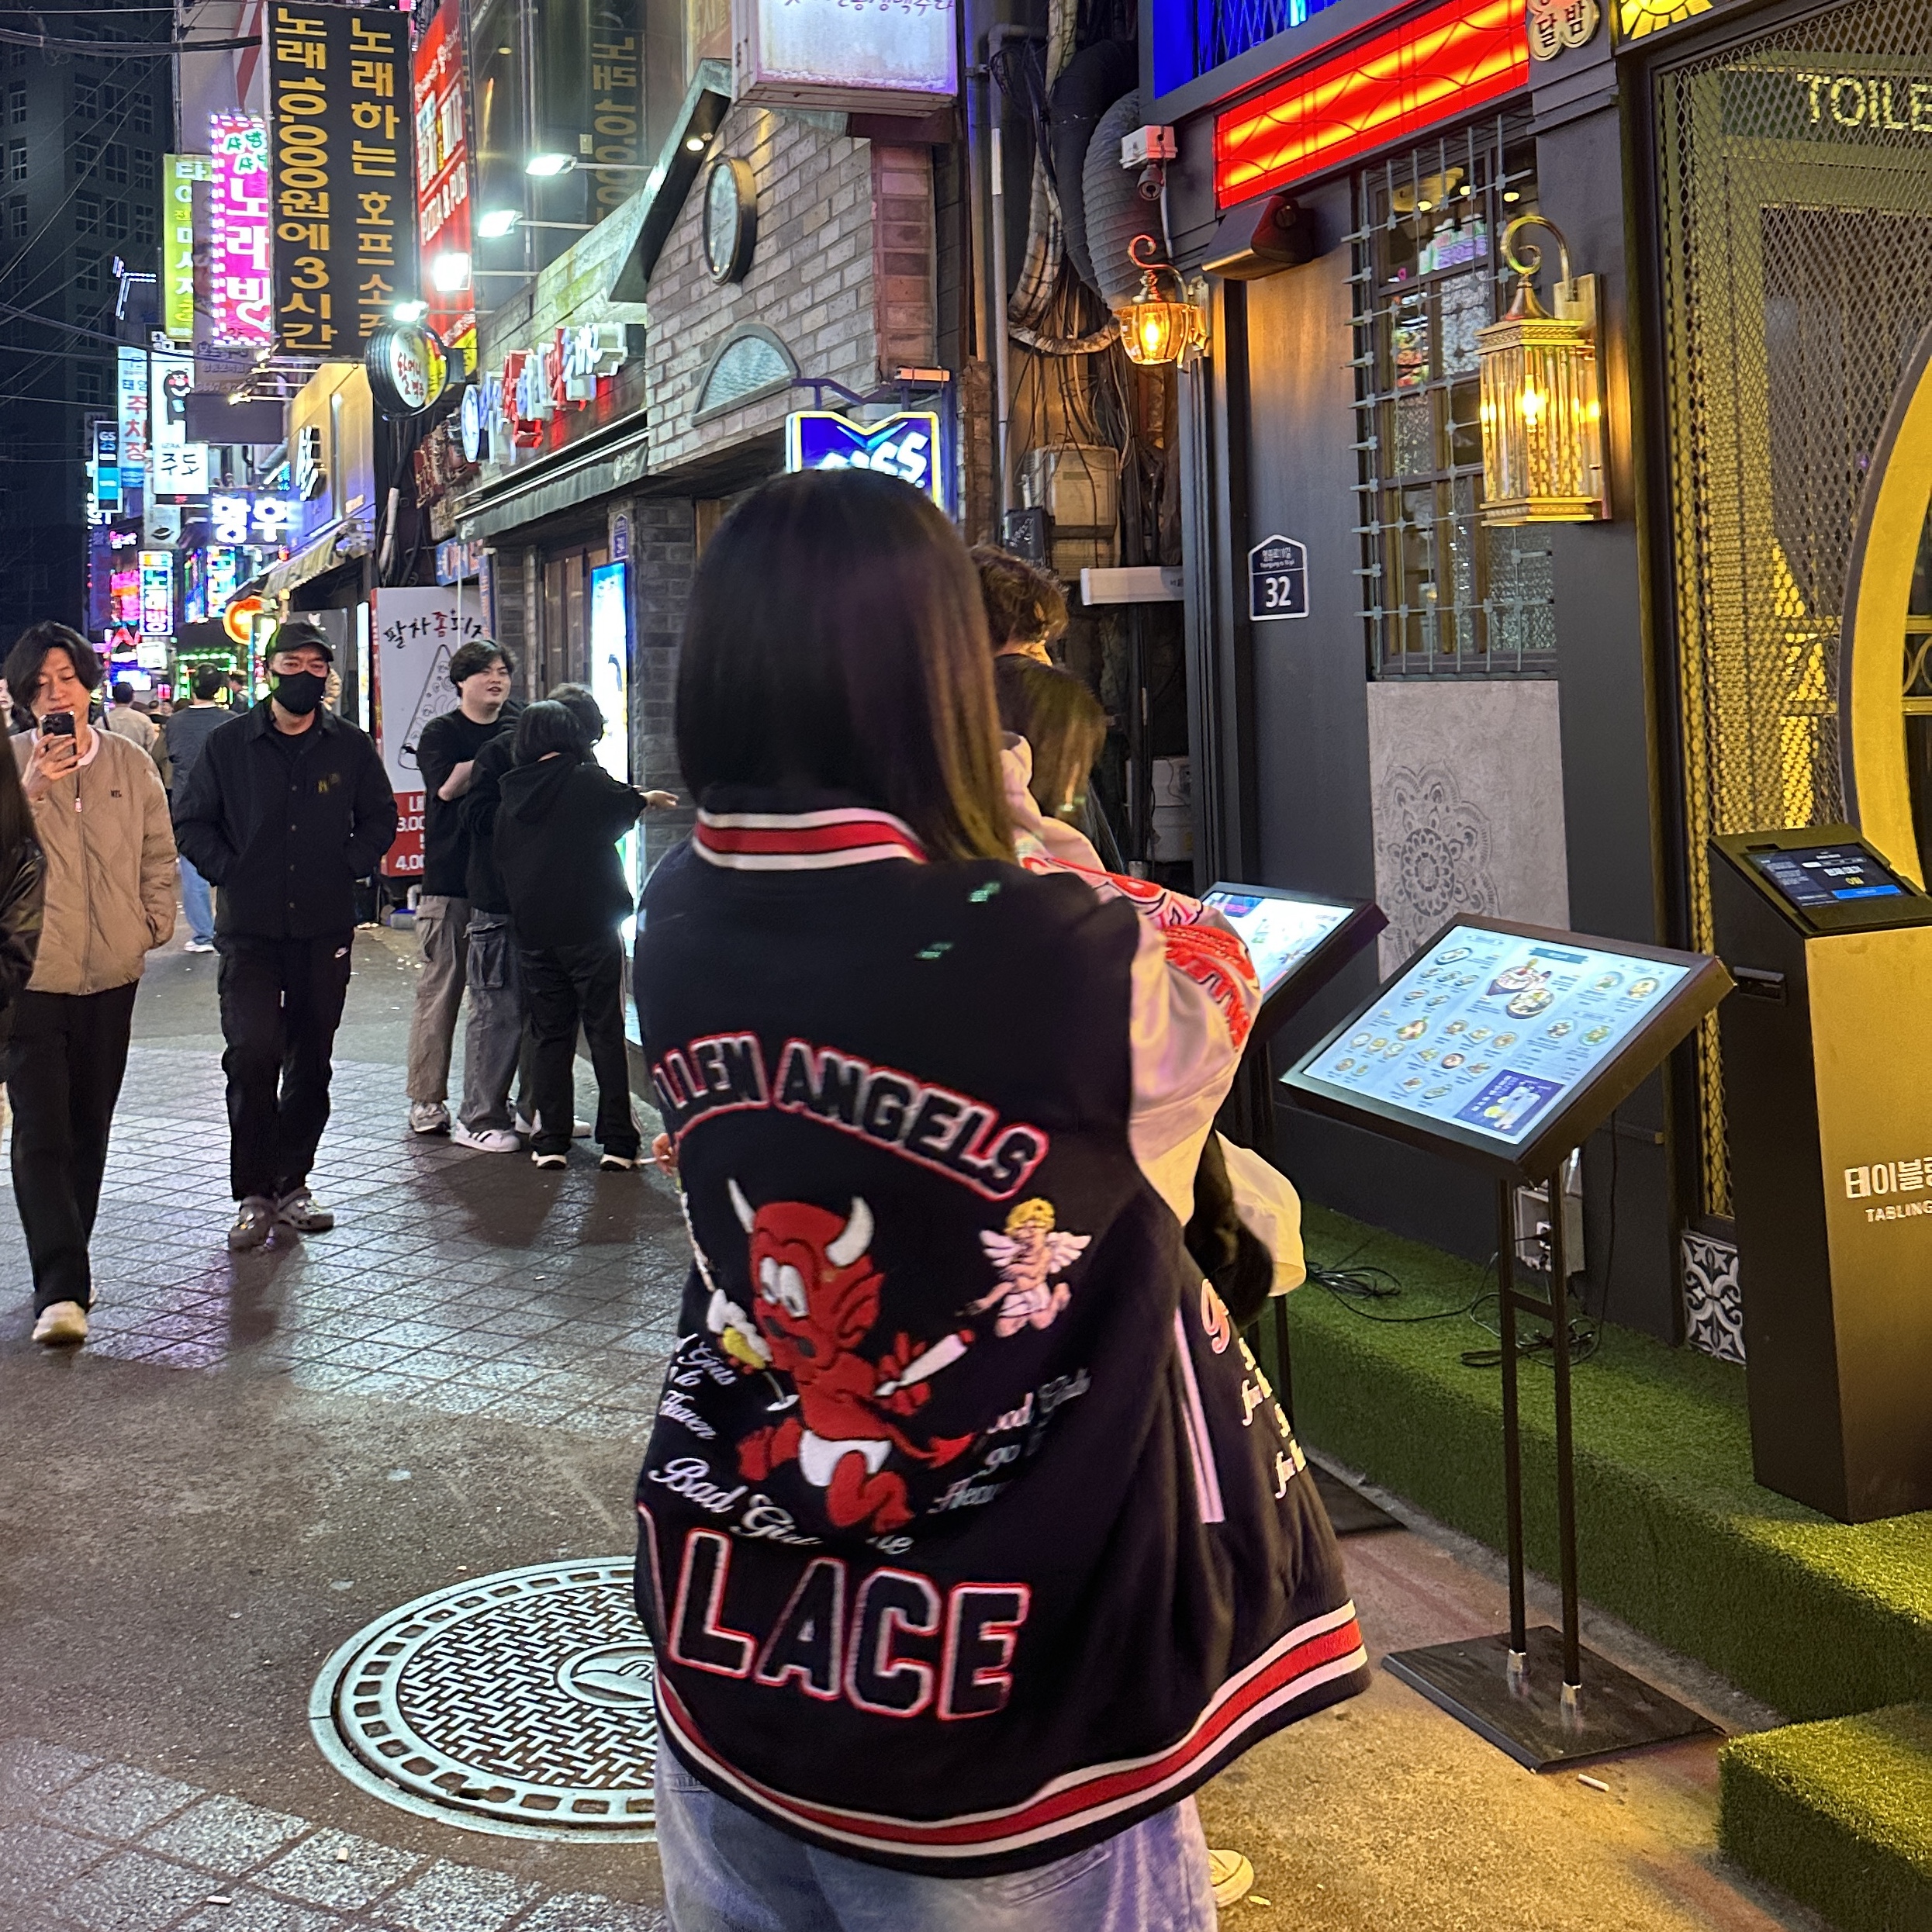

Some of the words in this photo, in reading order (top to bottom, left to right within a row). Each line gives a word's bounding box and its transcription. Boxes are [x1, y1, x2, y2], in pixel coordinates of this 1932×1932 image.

[275, 7, 328, 70] 노래
[350, 17, 401, 178] 노래하는
[280, 256, 339, 350] 3시간
[1265, 575, 1292, 607] 32
[774, 1036, 1051, 1202] ANGELS
[1865, 1200, 1932, 1223] TABLING
[648, 1457, 749, 1513] Bad
[651, 1523, 1032, 1722] LACE
